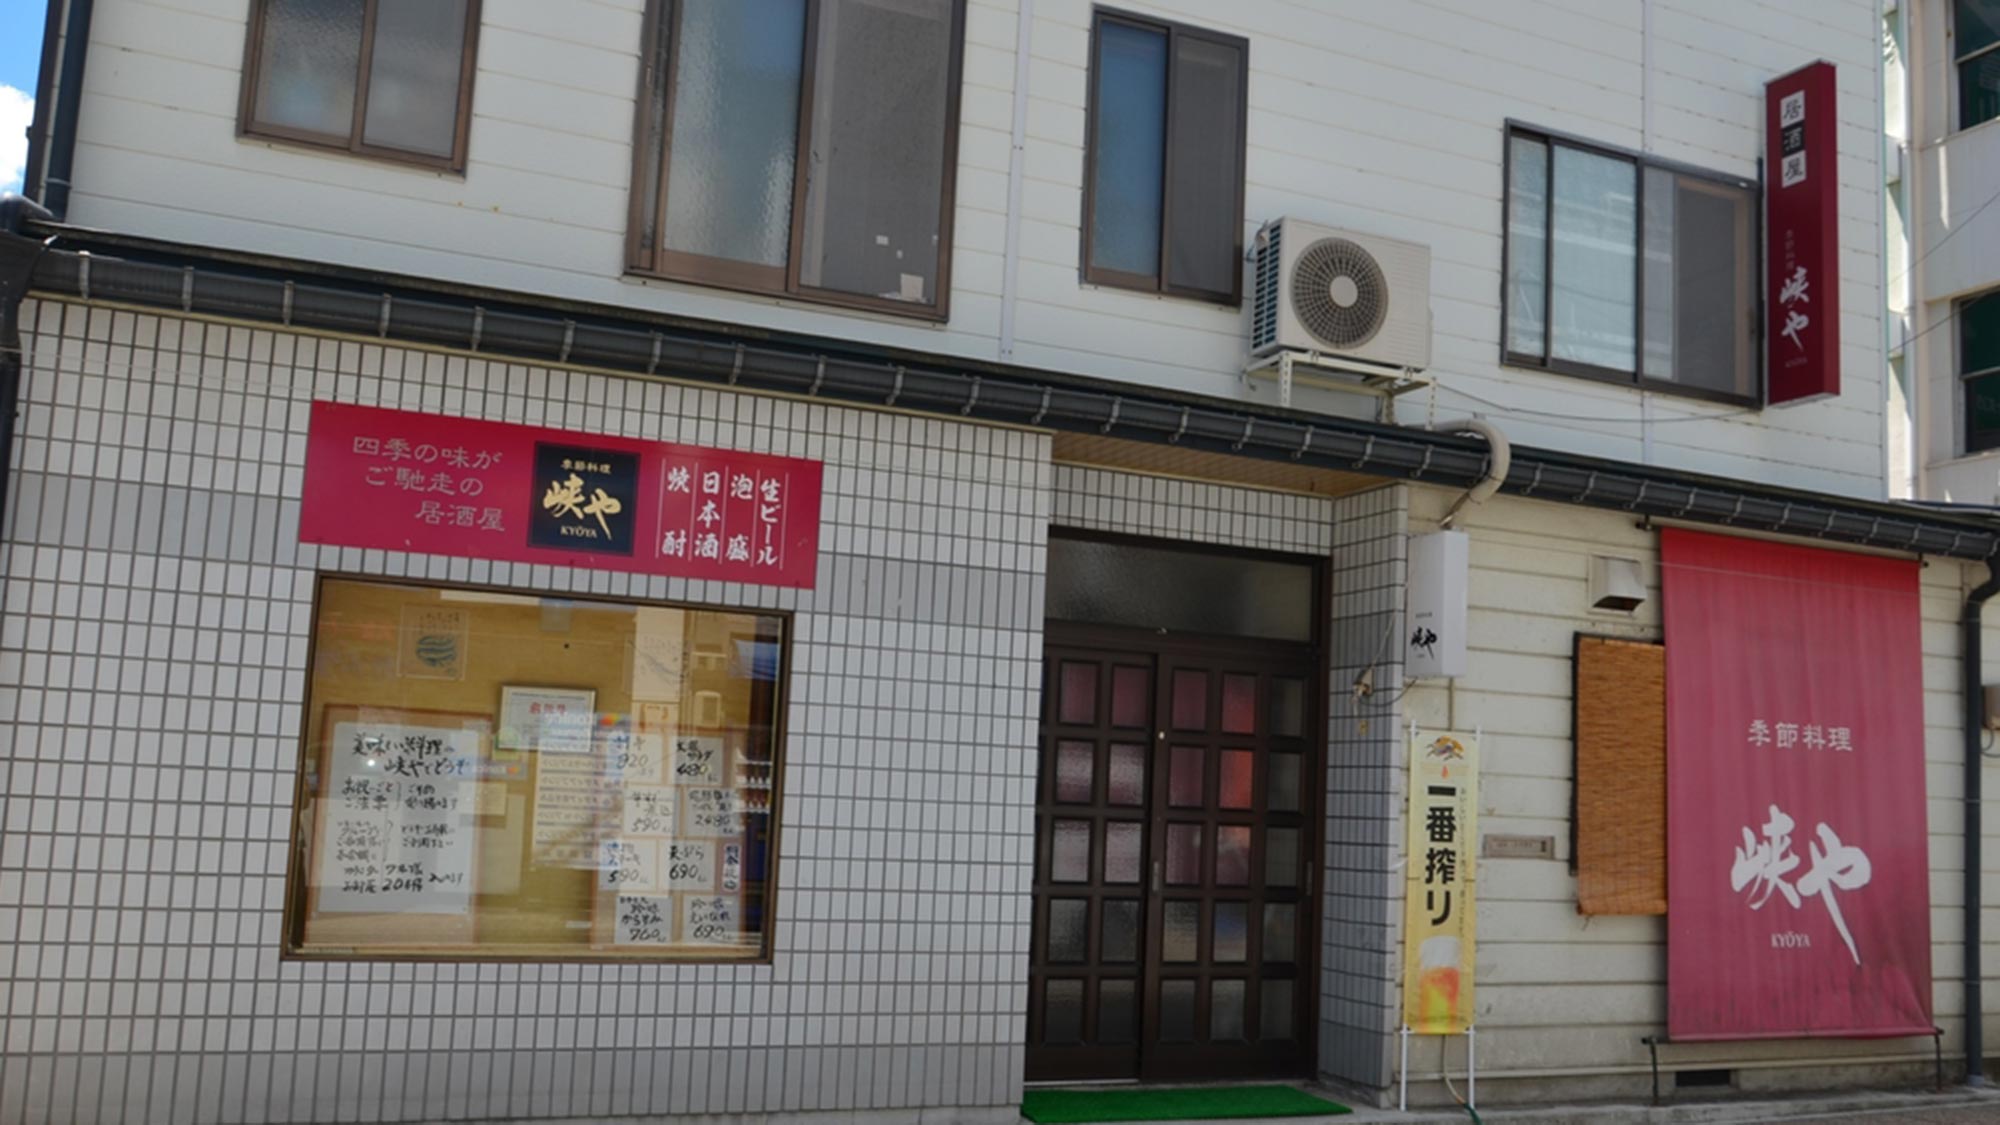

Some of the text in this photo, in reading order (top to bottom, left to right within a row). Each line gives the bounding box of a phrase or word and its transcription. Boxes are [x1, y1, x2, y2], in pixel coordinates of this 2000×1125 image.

[1782, 97, 1802, 180] 居酒屋
[1780, 266, 1809, 351] 峡や
[353, 436, 503, 470] 四季の味が
[366, 466, 483, 496] ご馳走の
[561, 458, 611, 475] 季節料理
[415, 500, 505, 531] 居酒屋
[543, 473, 622, 540] 峡や
[662, 466, 690, 557] 焼酎
[694, 471, 720, 559] 日本酒
[726, 473, 753, 561] 泡盛
[757, 478, 781, 565] 生ビール
[1748, 719, 1853, 751] 季節料理
[669, 863, 699, 881] 690
[1425, 786, 1456, 926] 一番搾り
[1731, 804, 1871, 965] 峡や
